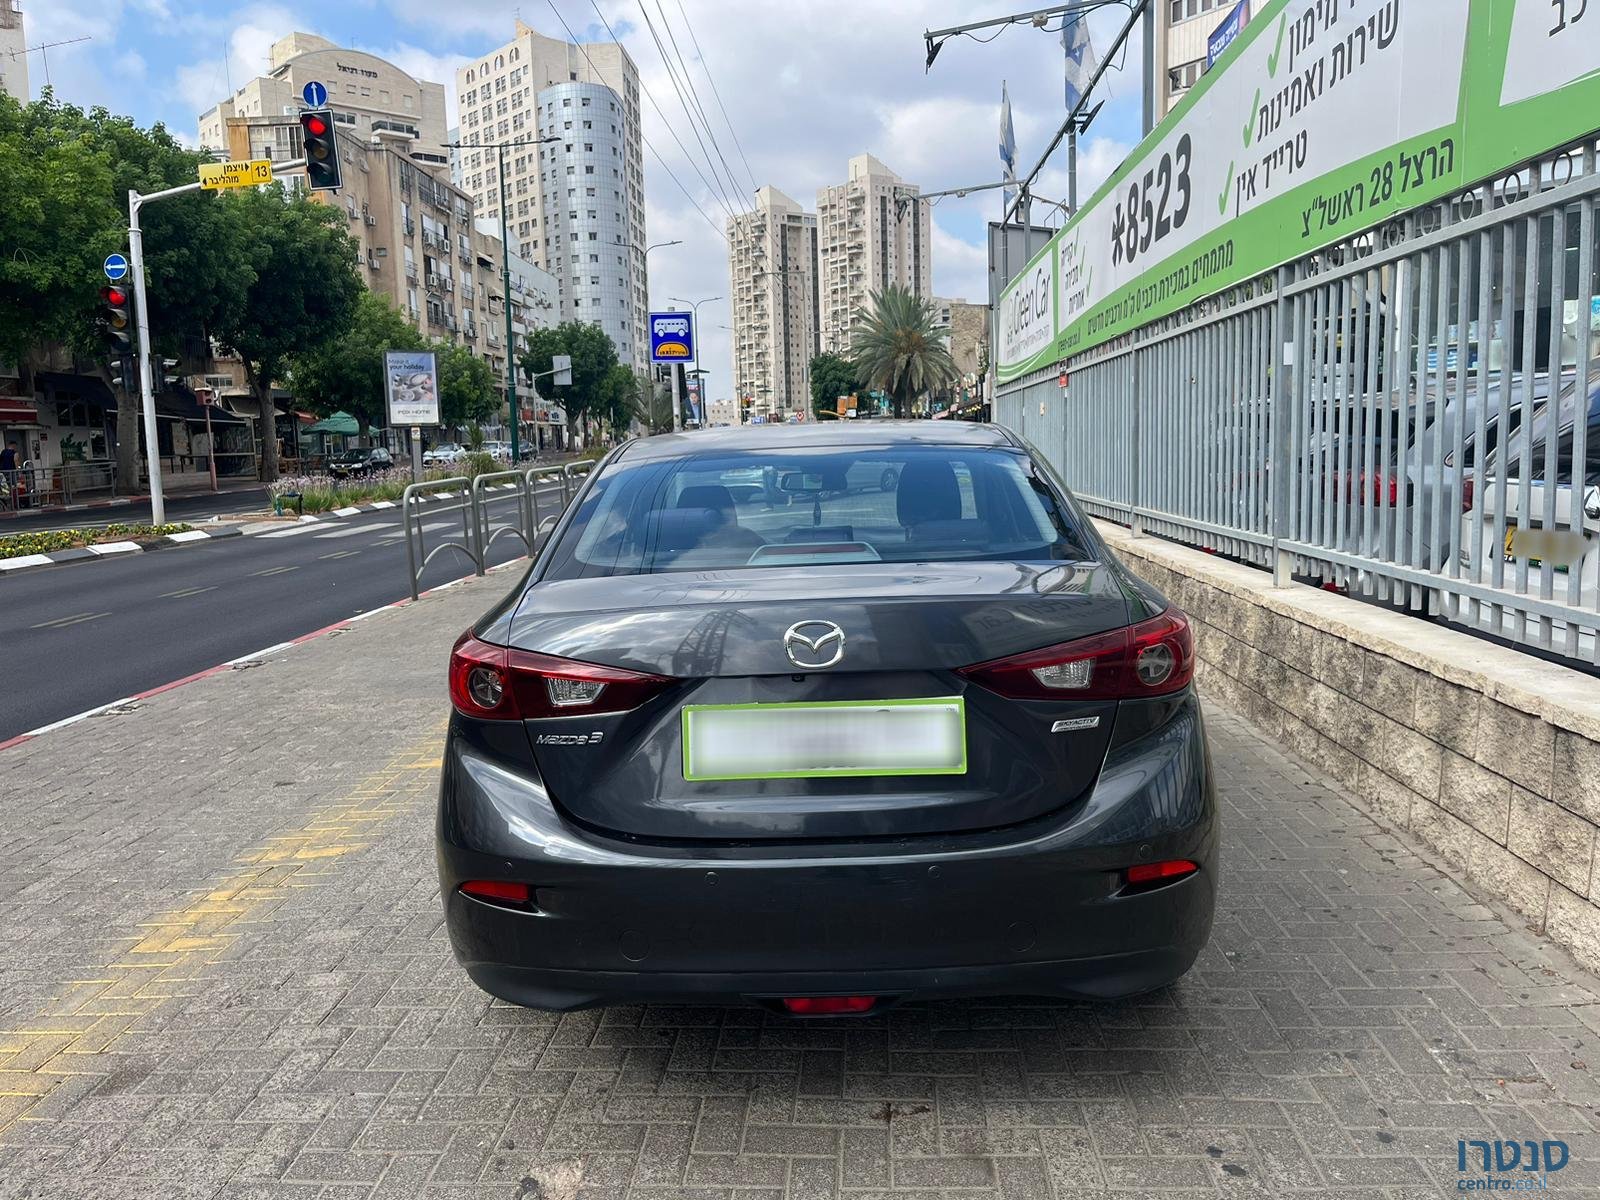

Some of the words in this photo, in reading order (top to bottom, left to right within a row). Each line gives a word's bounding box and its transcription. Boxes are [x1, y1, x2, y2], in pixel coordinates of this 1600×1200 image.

[1288, 0, 1338, 74] מימון
[1329, 0, 1400, 89] שירות
[1257, 57, 1325, 143] ואמינות
[208, 174, 239, 185] מוהליבר
[223, 163, 244, 175] ויצמן
[255, 165, 268, 178] 13
[1262, 129, 1307, 189] טרייד
[1369, 161, 1394, 208] 28
[1400, 138, 1454, 193] הרצל
[1235, 163, 1258, 218] אין
[1158, 264, 1190, 302] במכירת
[1192, 239, 1233, 285] מתמחים
[1036, 267, 1051, 319] Car
